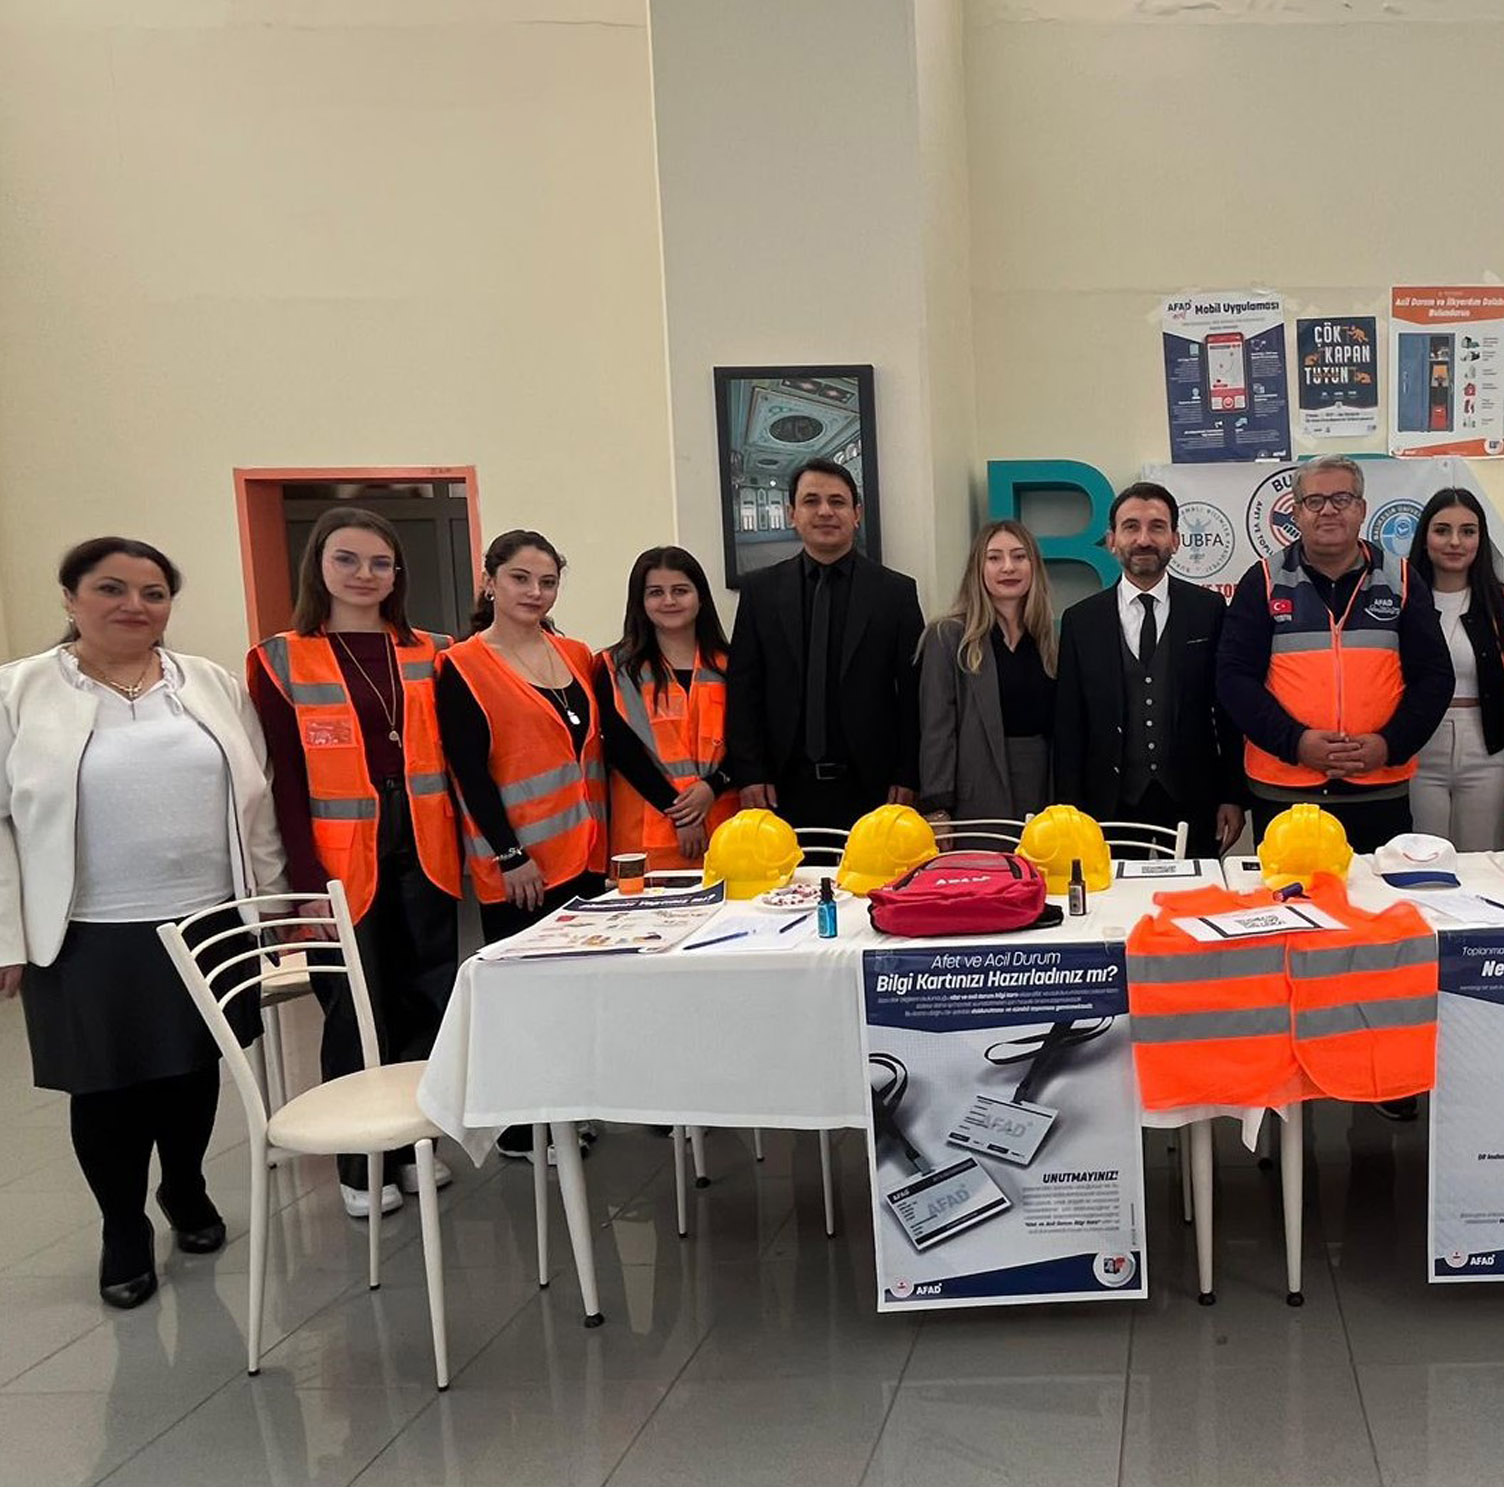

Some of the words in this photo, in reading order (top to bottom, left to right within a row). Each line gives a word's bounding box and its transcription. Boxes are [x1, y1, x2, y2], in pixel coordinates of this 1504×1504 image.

[1195, 303, 1221, 314] Mobil
[1223, 301, 1279, 314] Uygulaması
[1314, 322, 1341, 347] ÇÖK
[1325, 345, 1370, 364] KAPAN
[1304, 366, 1349, 385] TUTUN
[1182, 533, 1224, 547] UBFA
[931, 955, 960, 970] Afet
[965, 956, 983, 968] ve
[984, 952, 1010, 967] Acil
[1013, 951, 1061, 966] Durum
[1482, 960, 1504, 977] Ne
[877, 973, 913, 995] Bilgi
[916, 971, 984, 991] Kartınızı
[987, 967, 1083, 988] Hazırladınız
[1086, 965, 1119, 982] mı?
[1042, 1170, 1119, 1183] UNUTMAYINIZ!
[1470, 1255, 1495, 1266] AFAD
[916, 1285, 941, 1295] AFAD
